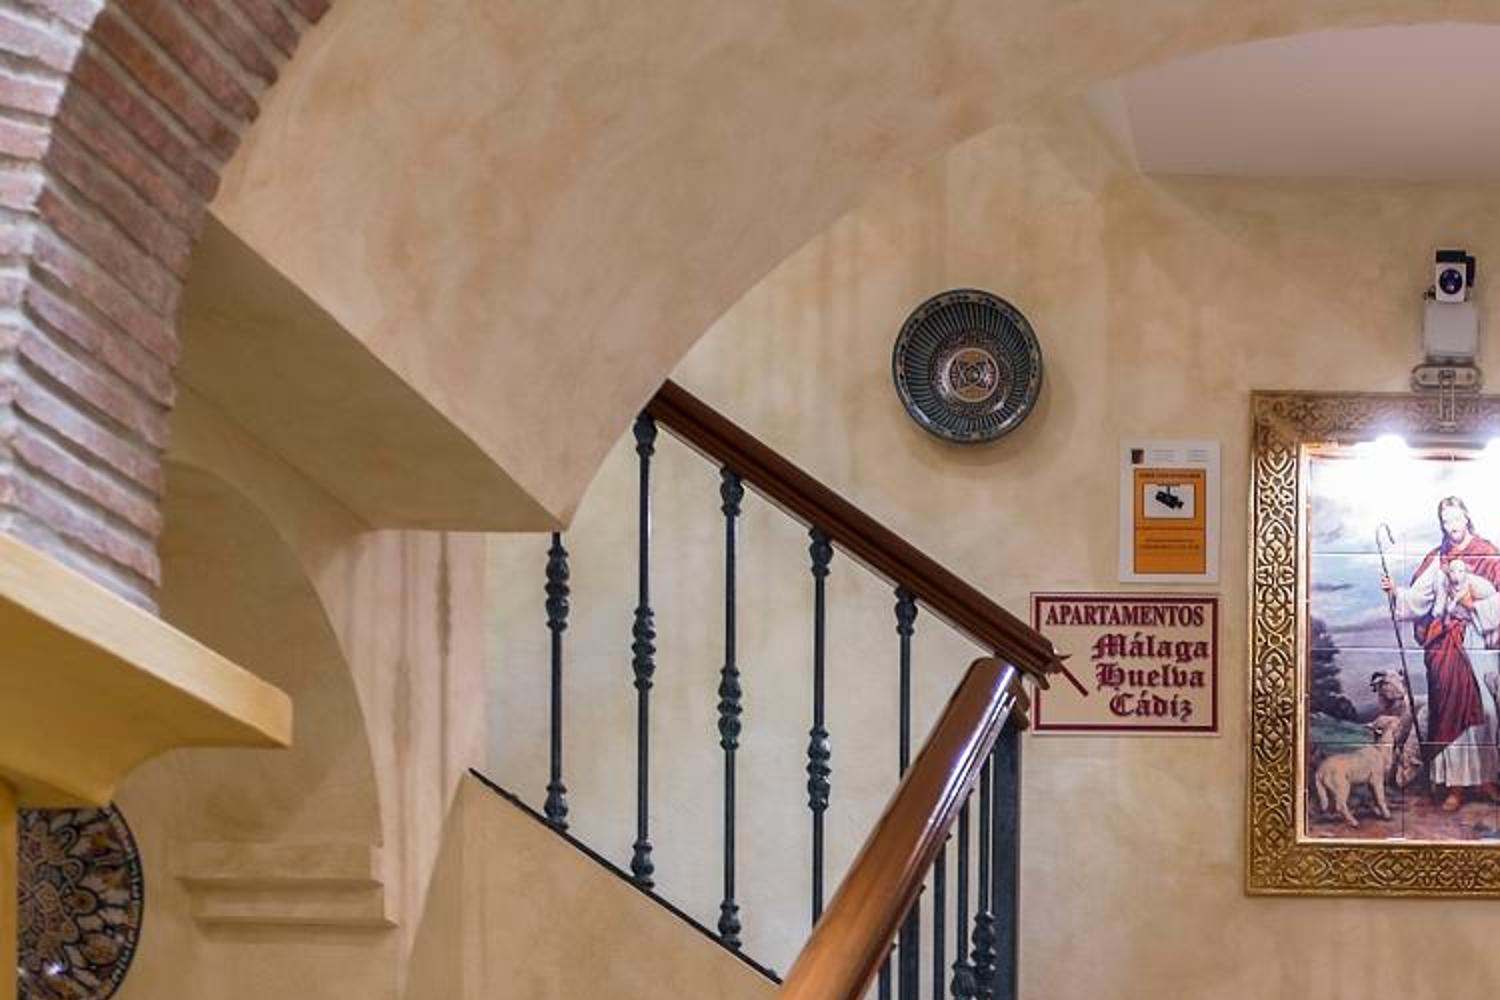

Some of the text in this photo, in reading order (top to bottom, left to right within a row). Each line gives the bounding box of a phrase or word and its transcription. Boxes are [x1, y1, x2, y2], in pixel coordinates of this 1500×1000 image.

[1045, 605, 1204, 627] APARTAMENTOS
[1091, 632, 1210, 663] Málaga
[1096, 662, 1206, 690] Huelva
[1109, 690, 1194, 722] Cádiz
